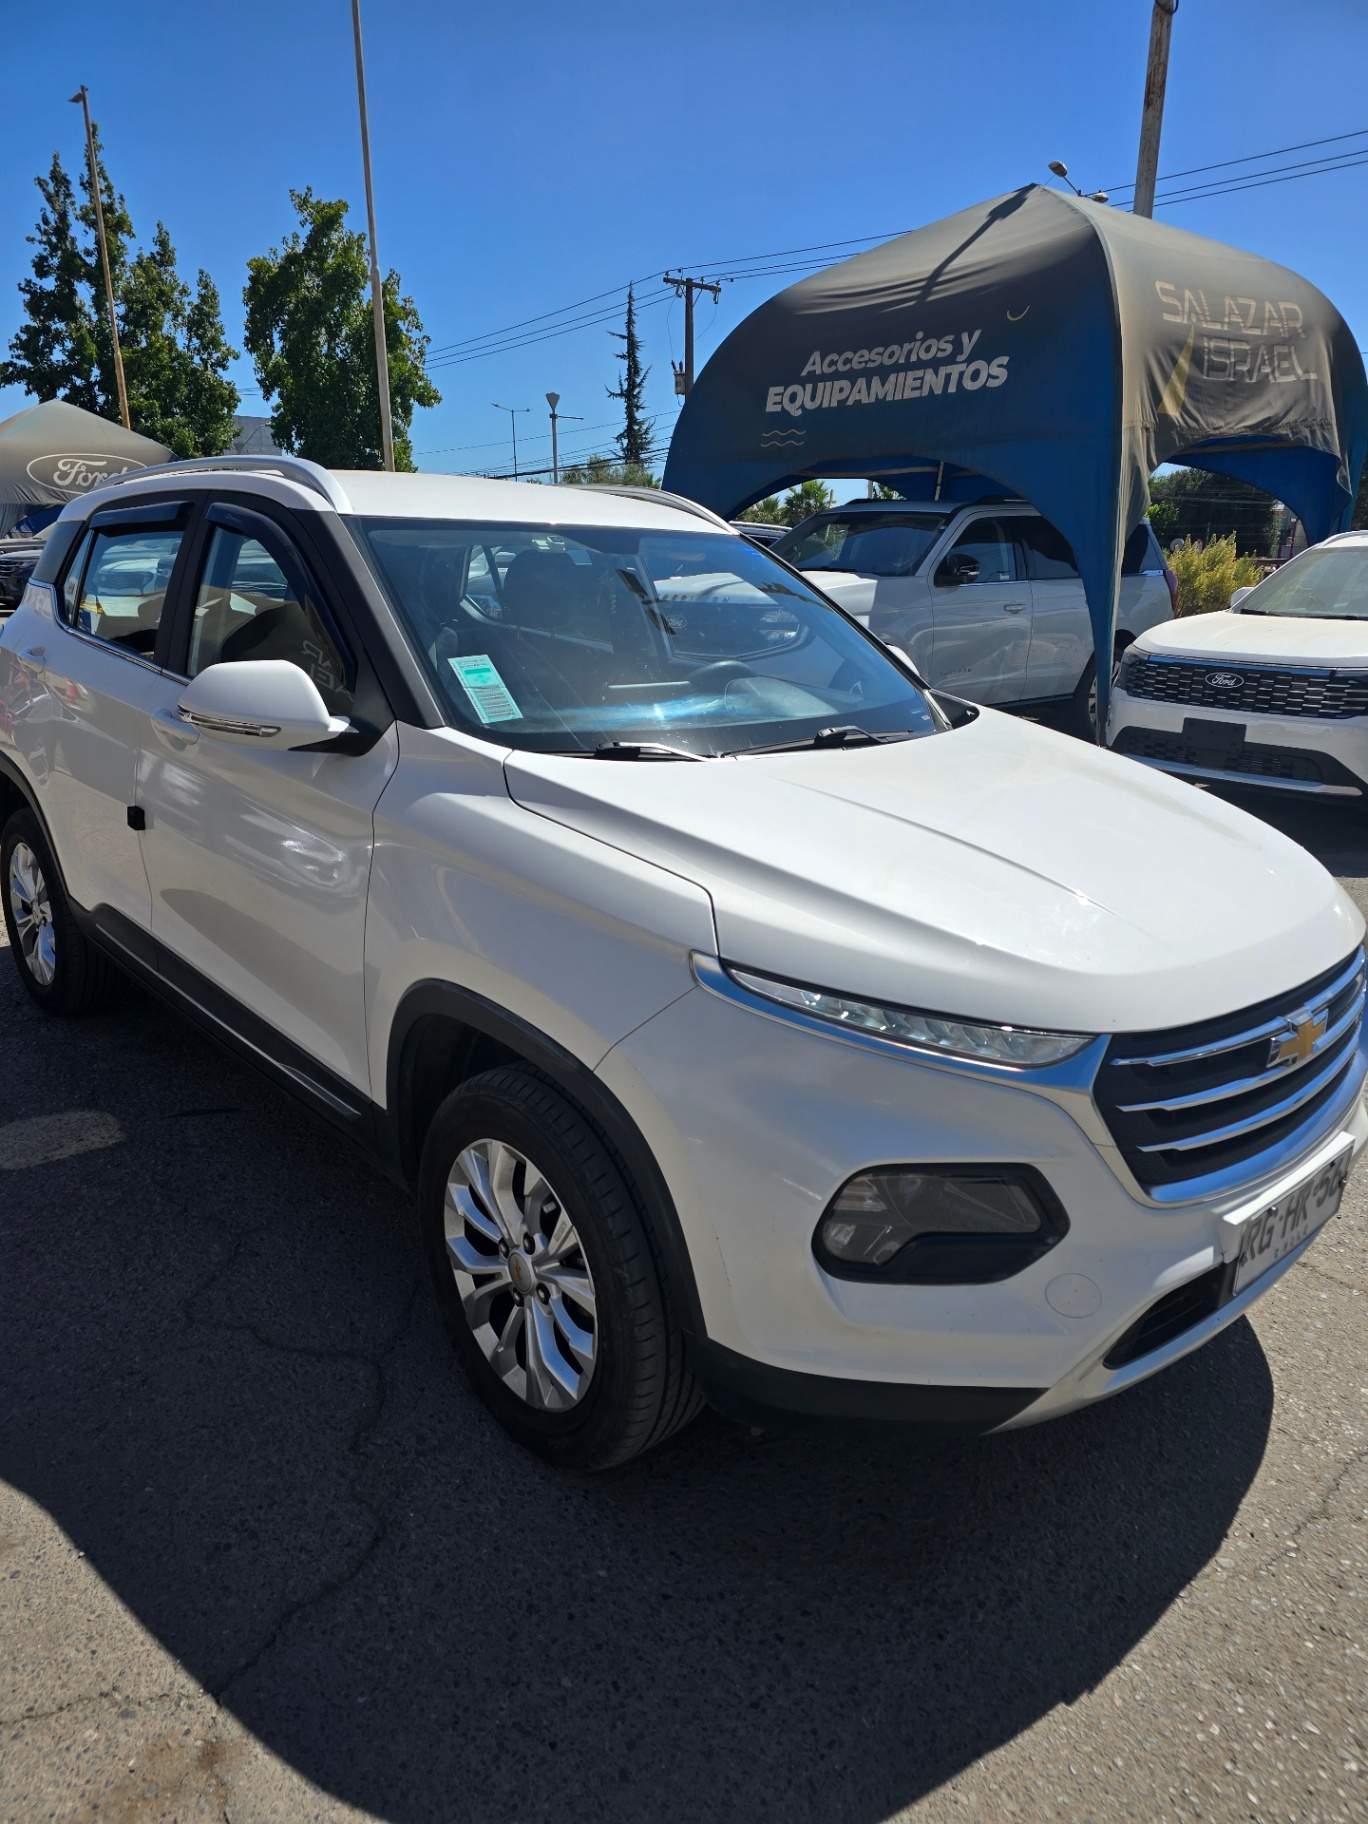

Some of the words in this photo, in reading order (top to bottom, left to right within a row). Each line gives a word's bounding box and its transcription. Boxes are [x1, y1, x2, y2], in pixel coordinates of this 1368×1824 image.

[1154, 279, 1305, 338] SALAZAR
[801, 331, 954, 376] Accesorios
[956, 328, 981, 362] y
[1202, 336, 1318, 384] ISRAEL
[765, 355, 1009, 416] EQUIPAMIENTOS
[1211, 673, 1237, 686] Ford
